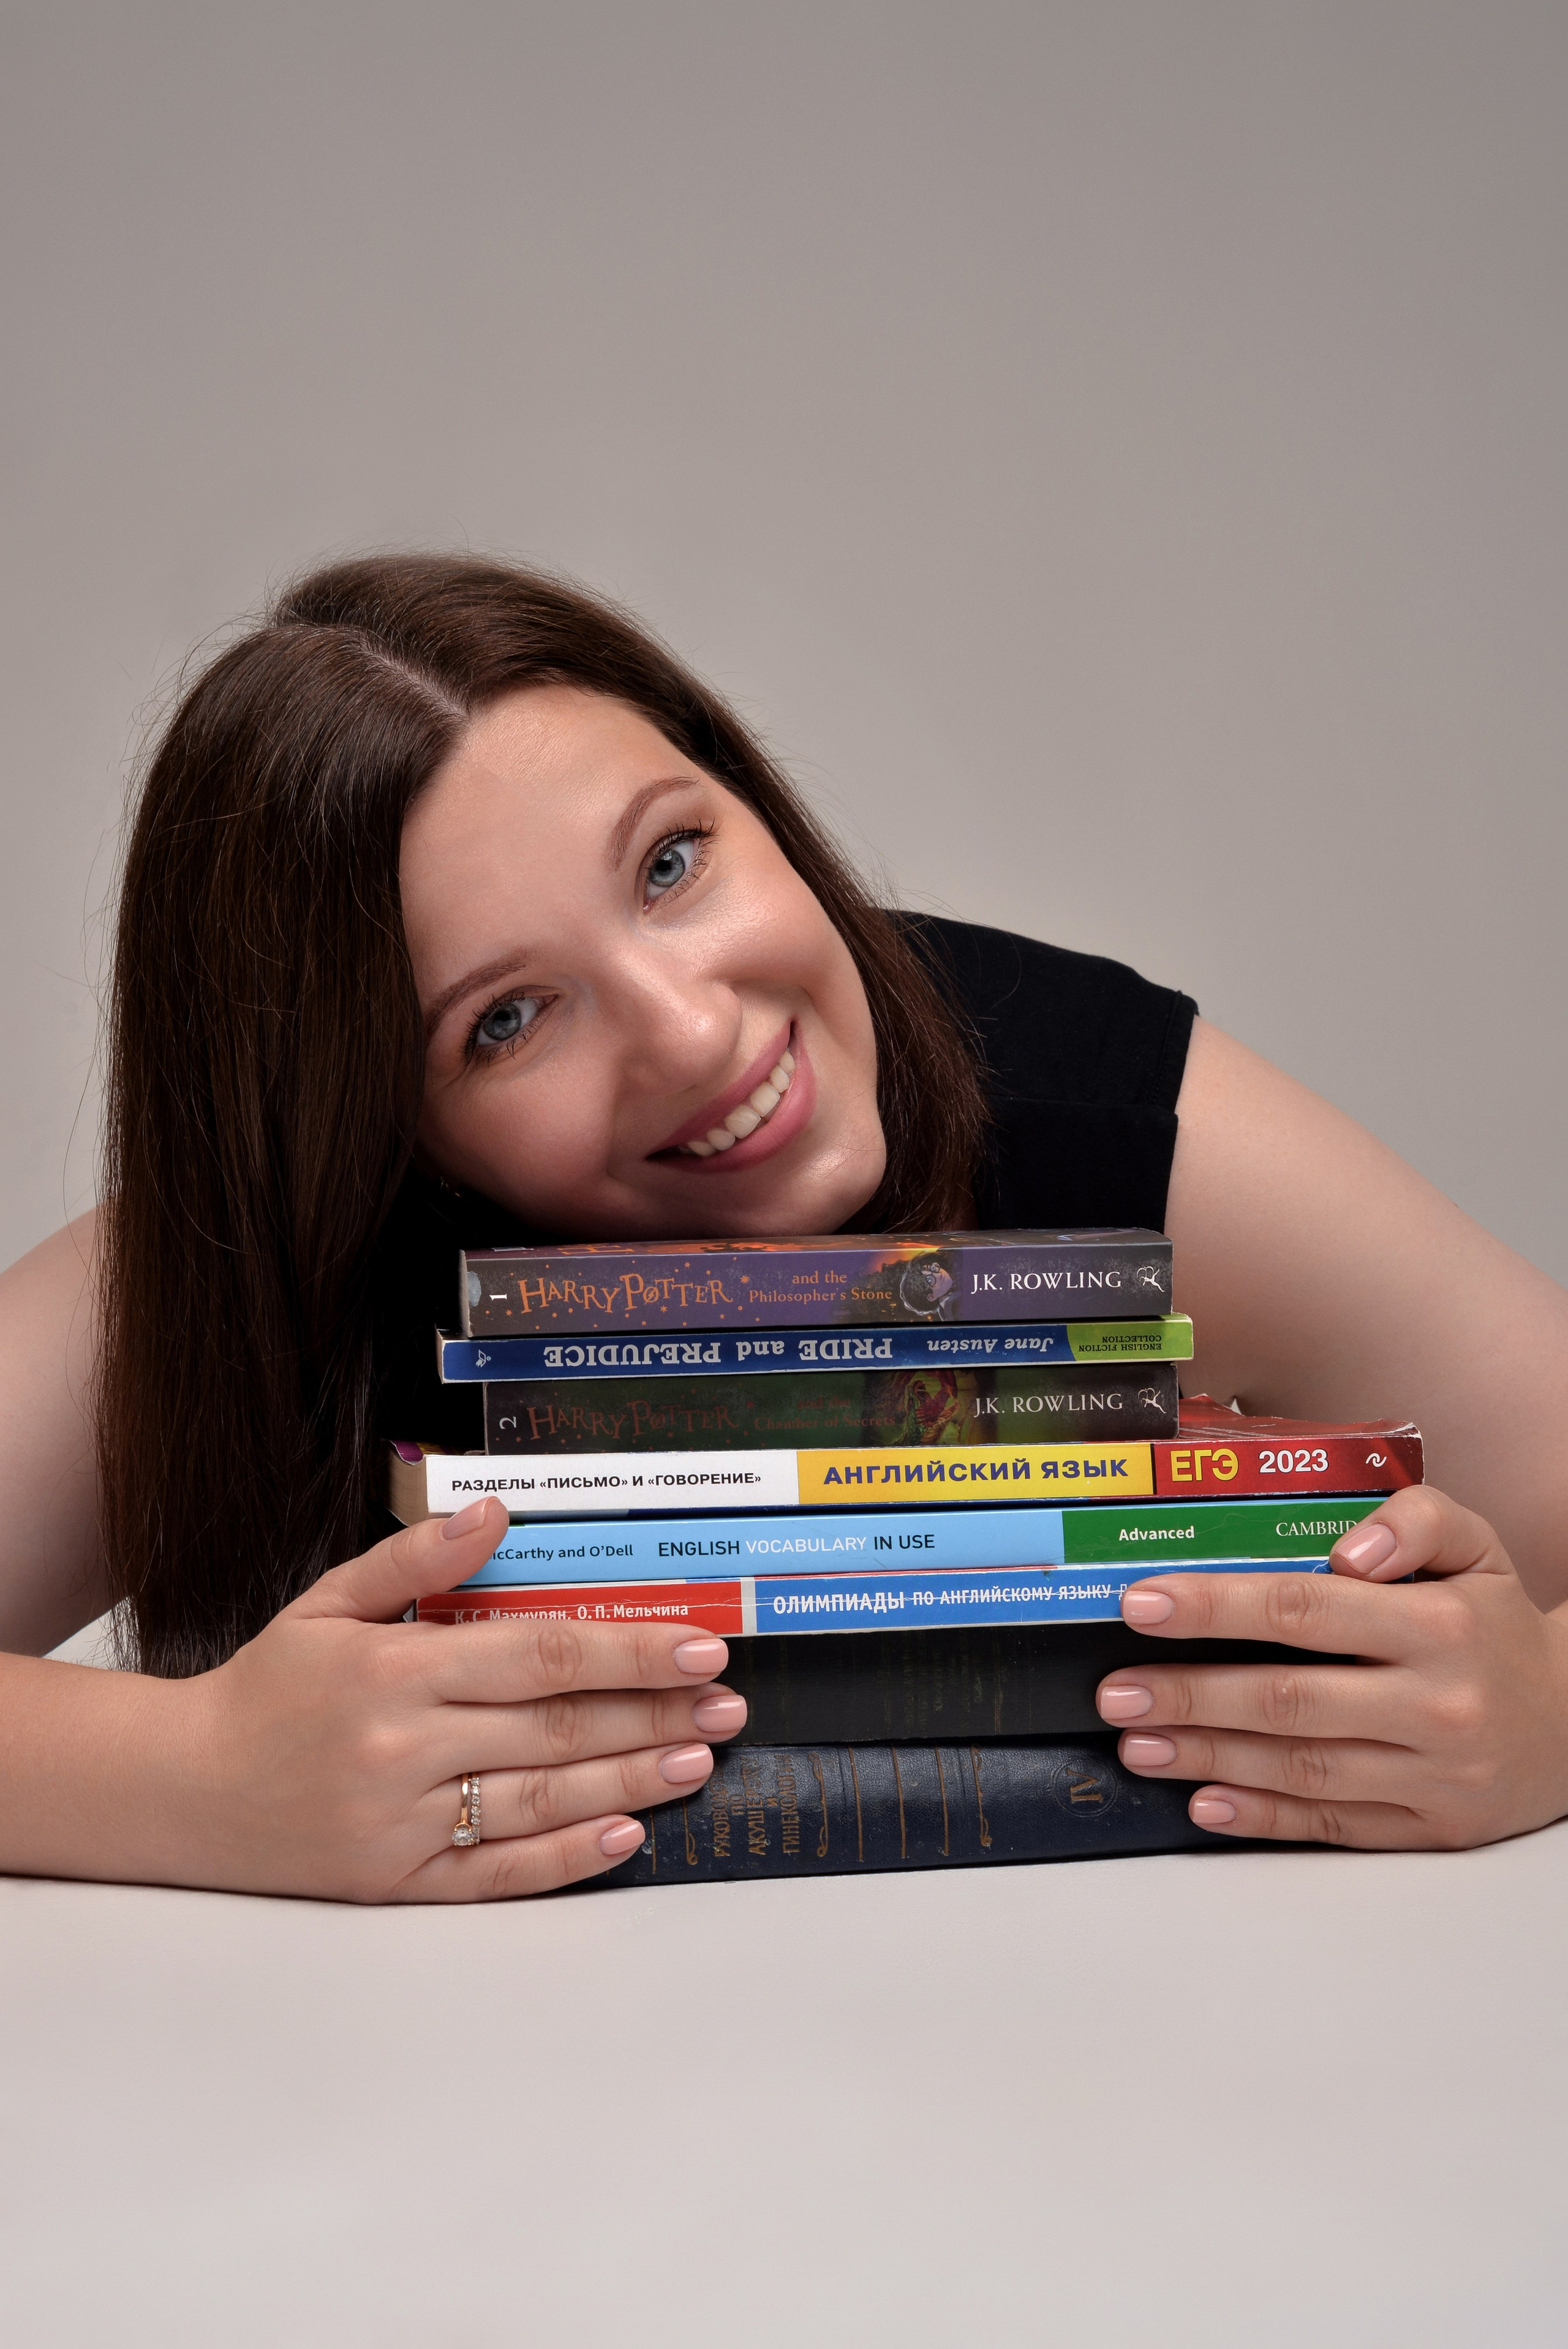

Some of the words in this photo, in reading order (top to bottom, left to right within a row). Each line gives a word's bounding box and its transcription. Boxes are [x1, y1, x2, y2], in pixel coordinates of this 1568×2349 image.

[792, 1270, 820, 1284] and
[824, 1270, 847, 1284] the
[971, 1273, 1003, 1295] J.K.
[1011, 1271, 1122, 1290] ROWLING
[489, 1292, 507, 1302] 1
[518, 1276, 620, 1314] HARRY
[619, 1273, 734, 1311] POTTER
[749, 1288, 846, 1305] Philosopher's
[850, 1287, 892, 1300] Stone
[926, 1338, 996, 1352] Austen
[1004, 1337, 1055, 1352] Jane
[1078, 1344, 1117, 1352] FICTION
[1101, 1335, 1162, 1343] COLLECTION
[1120, 1342, 1163, 1351] ENGLISH
[543, 1341, 722, 1367] PREJUDICE
[736, 1341, 785, 1362] and
[797, 1338, 892, 1361] PRIDE
[797, 1396, 823, 1410] and
[828, 1396, 851, 1409] the
[973, 1397, 1005, 1418] J.K.
[1012, 1393, 1123, 1414] ROWLING
[499, 1416, 517, 1430] 2
[527, 1404, 629, 1441] HARRY
[627, 1399, 741, 1437] POTTER
[754, 1414, 818, 1430] Chamber
[825, 1414, 840, 1428] of
[843, 1413, 896, 1428] Secrets
[823, 1457, 1031, 1485] АНГЛИЙСКИЙ
[1040, 1458, 1129, 1479] ЯЗЫК
[1170, 1448, 1240, 1482] ЕГЭ
[1259, 1449, 1330, 1474] 2023
[452, 1479, 535, 1492] РАЗДЕЛЫ
[540, 1476, 628, 1489] «ПИСЬМО»
[632, 1475, 644, 1487] И
[647, 1472, 762, 1486] «ГОВОРЕНИЕ»
[1118, 1525, 1195, 1542] Advanced
[558, 1545, 586, 1558] and
[658, 1540, 740, 1557] ENGLISH
[745, 1536, 867, 1555] VOCABULARY
[873, 1536, 893, 1551] IN
[899, 1534, 935, 1550] USE
[773, 1590, 905, 1615] ОЛИМПИАДЫ
[913, 1590, 935, 1607] ПО
[939, 1584, 1052, 1605] АНГЛИЙСКОМУ
[1058, 1583, 1112, 1600] ЯЗЫКУ
[614, 1604, 689, 1619] Мельчина
[1066, 1768, 1102, 1804] IV
[730, 1793, 744, 1815] ПО
[774, 1754, 801, 1853] ГИНЕКОЛОГИИ
